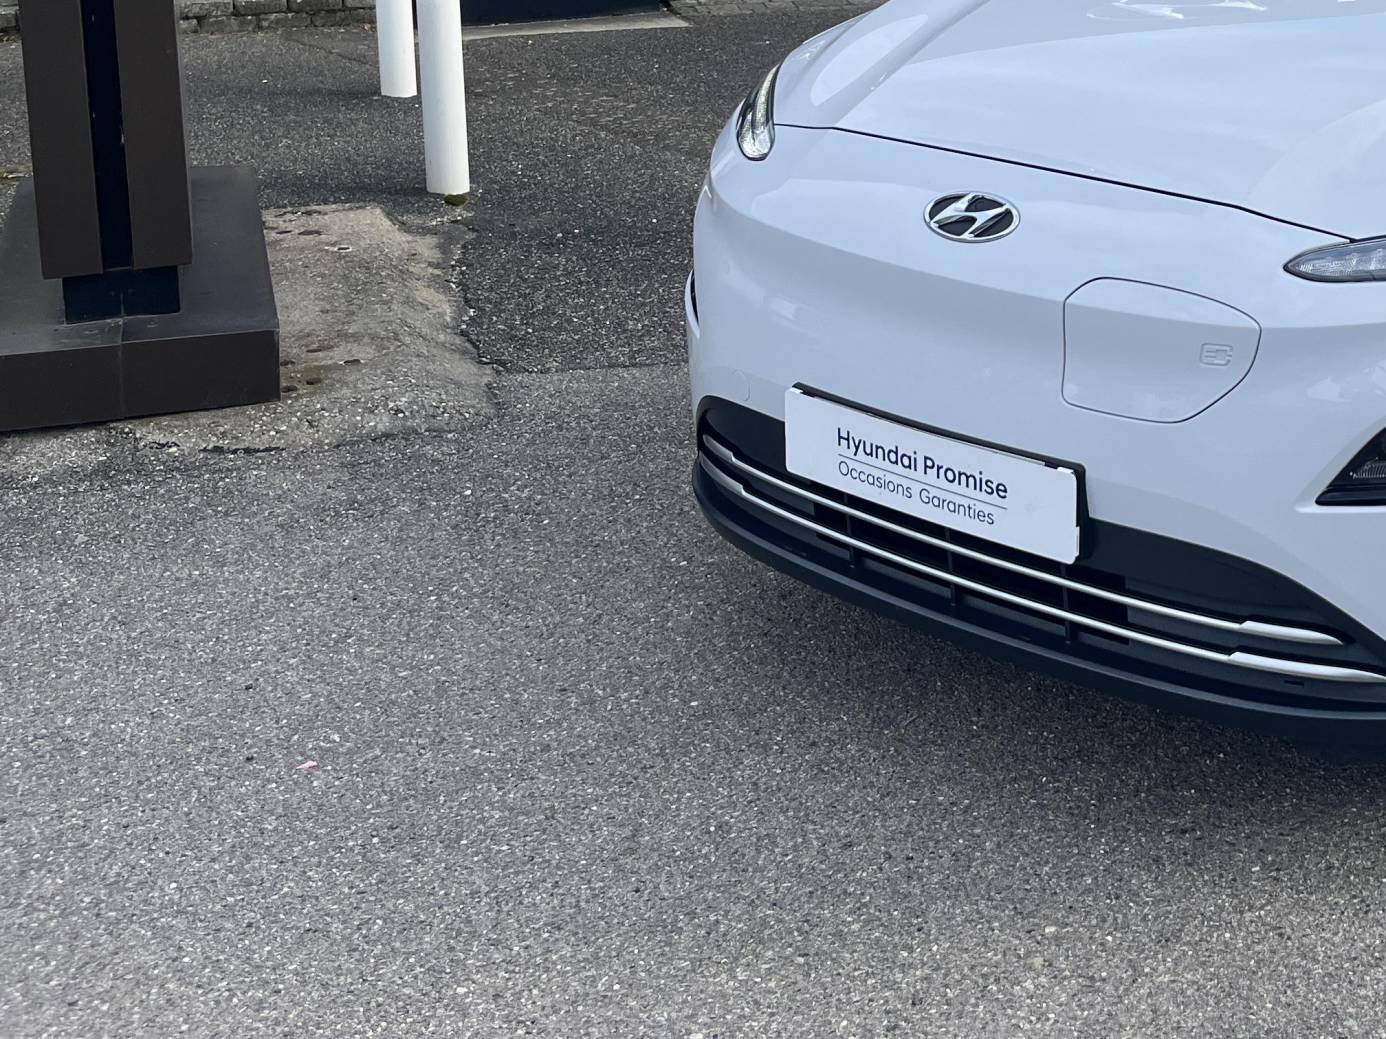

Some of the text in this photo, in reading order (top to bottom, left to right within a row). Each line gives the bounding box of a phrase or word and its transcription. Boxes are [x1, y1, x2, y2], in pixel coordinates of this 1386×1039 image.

[837, 427, 1008, 500] Hyundai Promise
[838, 460, 995, 526] Occasions Garanties
